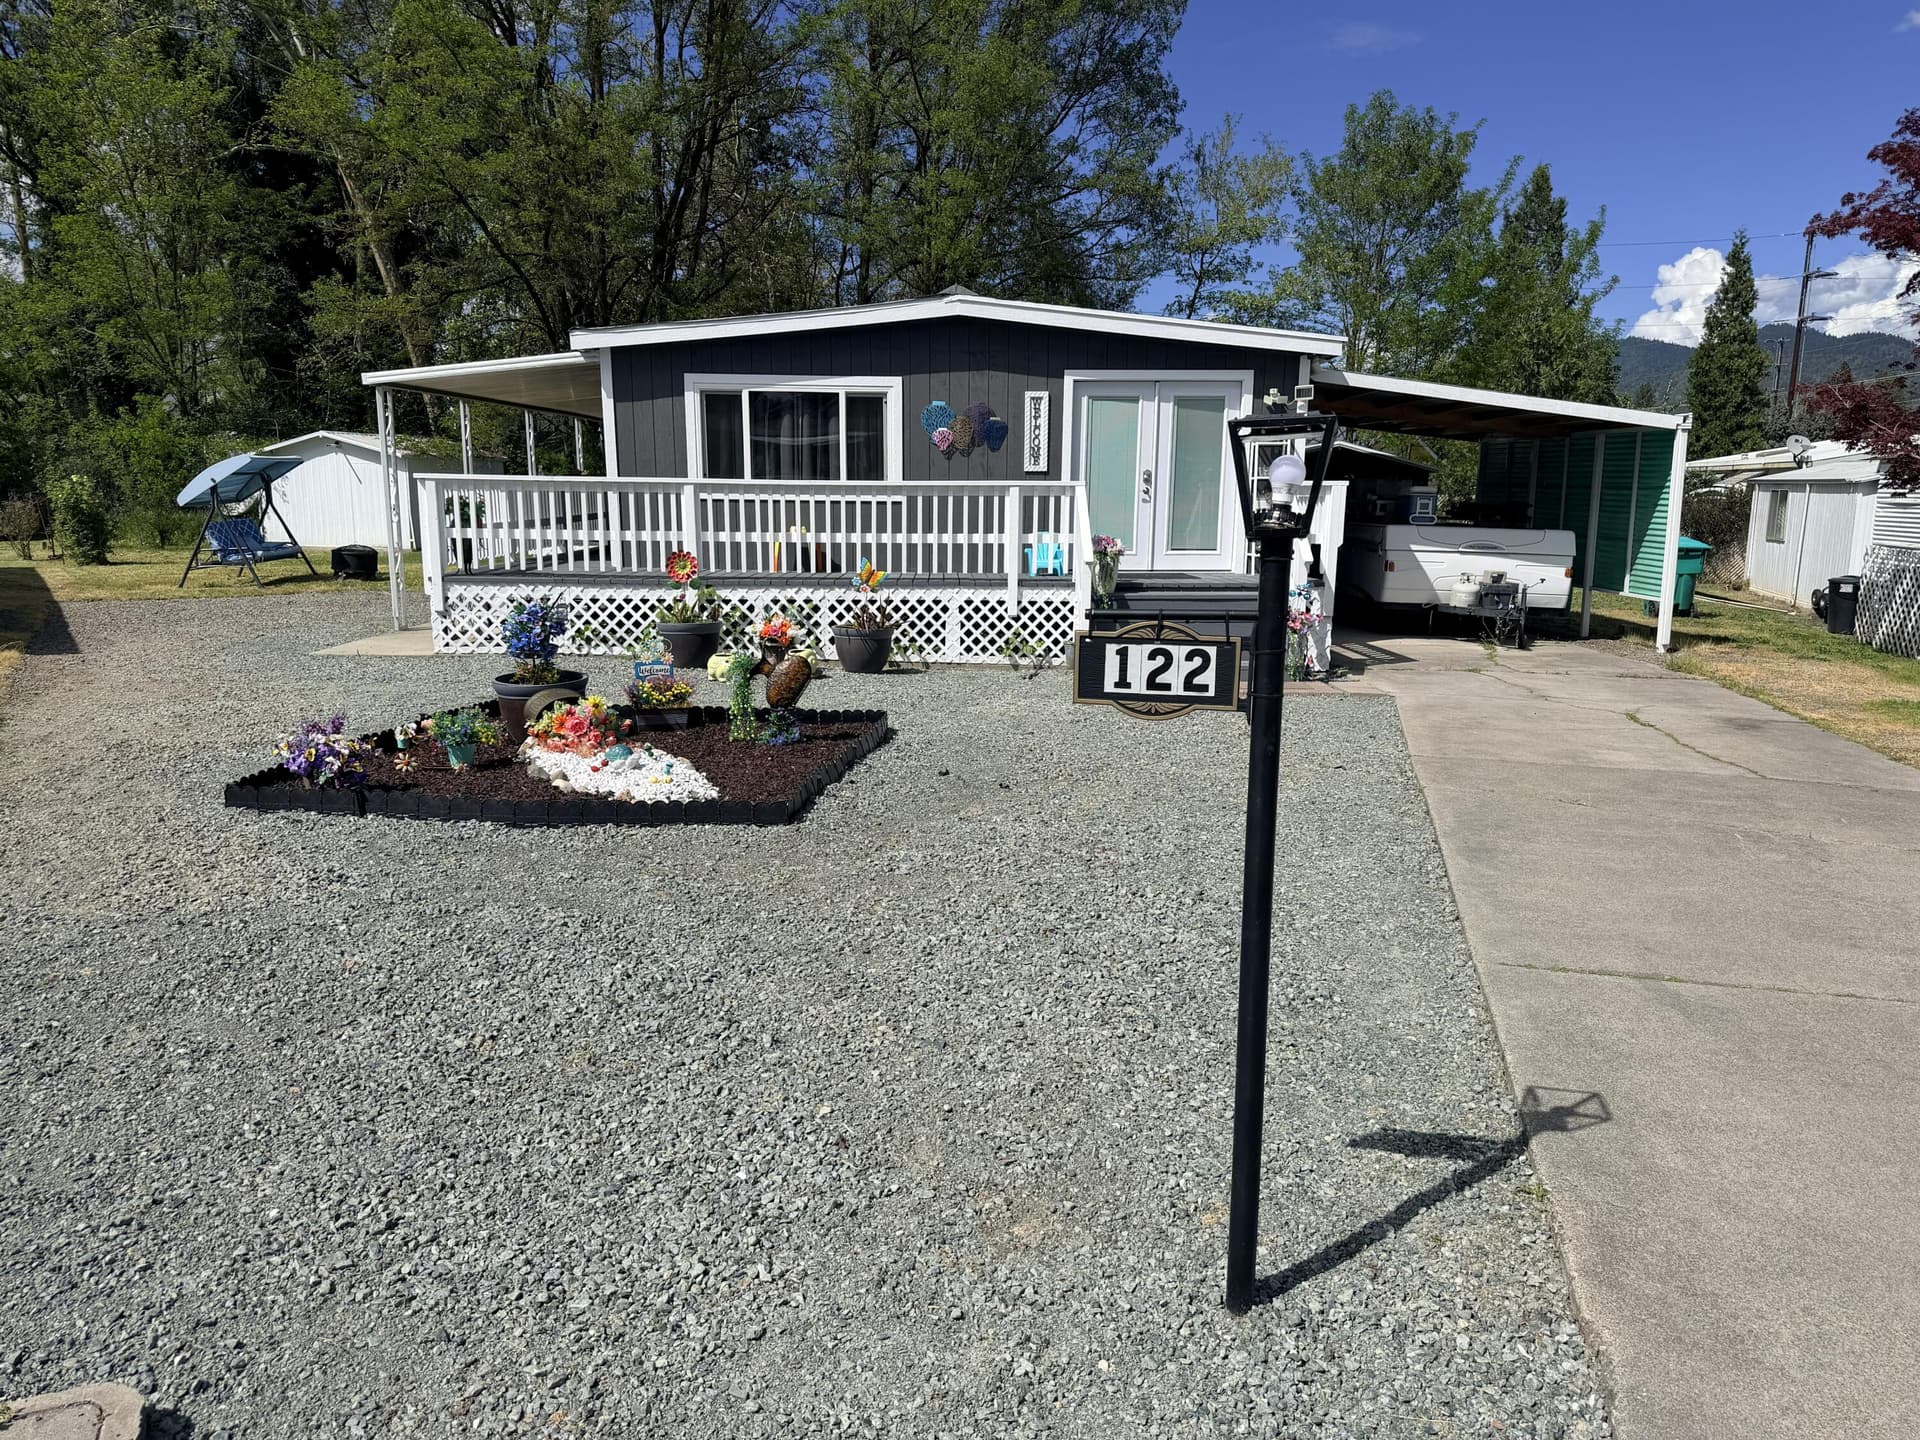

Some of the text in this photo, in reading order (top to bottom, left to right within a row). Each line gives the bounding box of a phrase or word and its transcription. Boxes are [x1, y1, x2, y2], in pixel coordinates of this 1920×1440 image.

[1031, 398, 1042, 466] WELCOME
[639, 666, 669, 674] Welcome
[1114, 646, 1211, 692] 122
